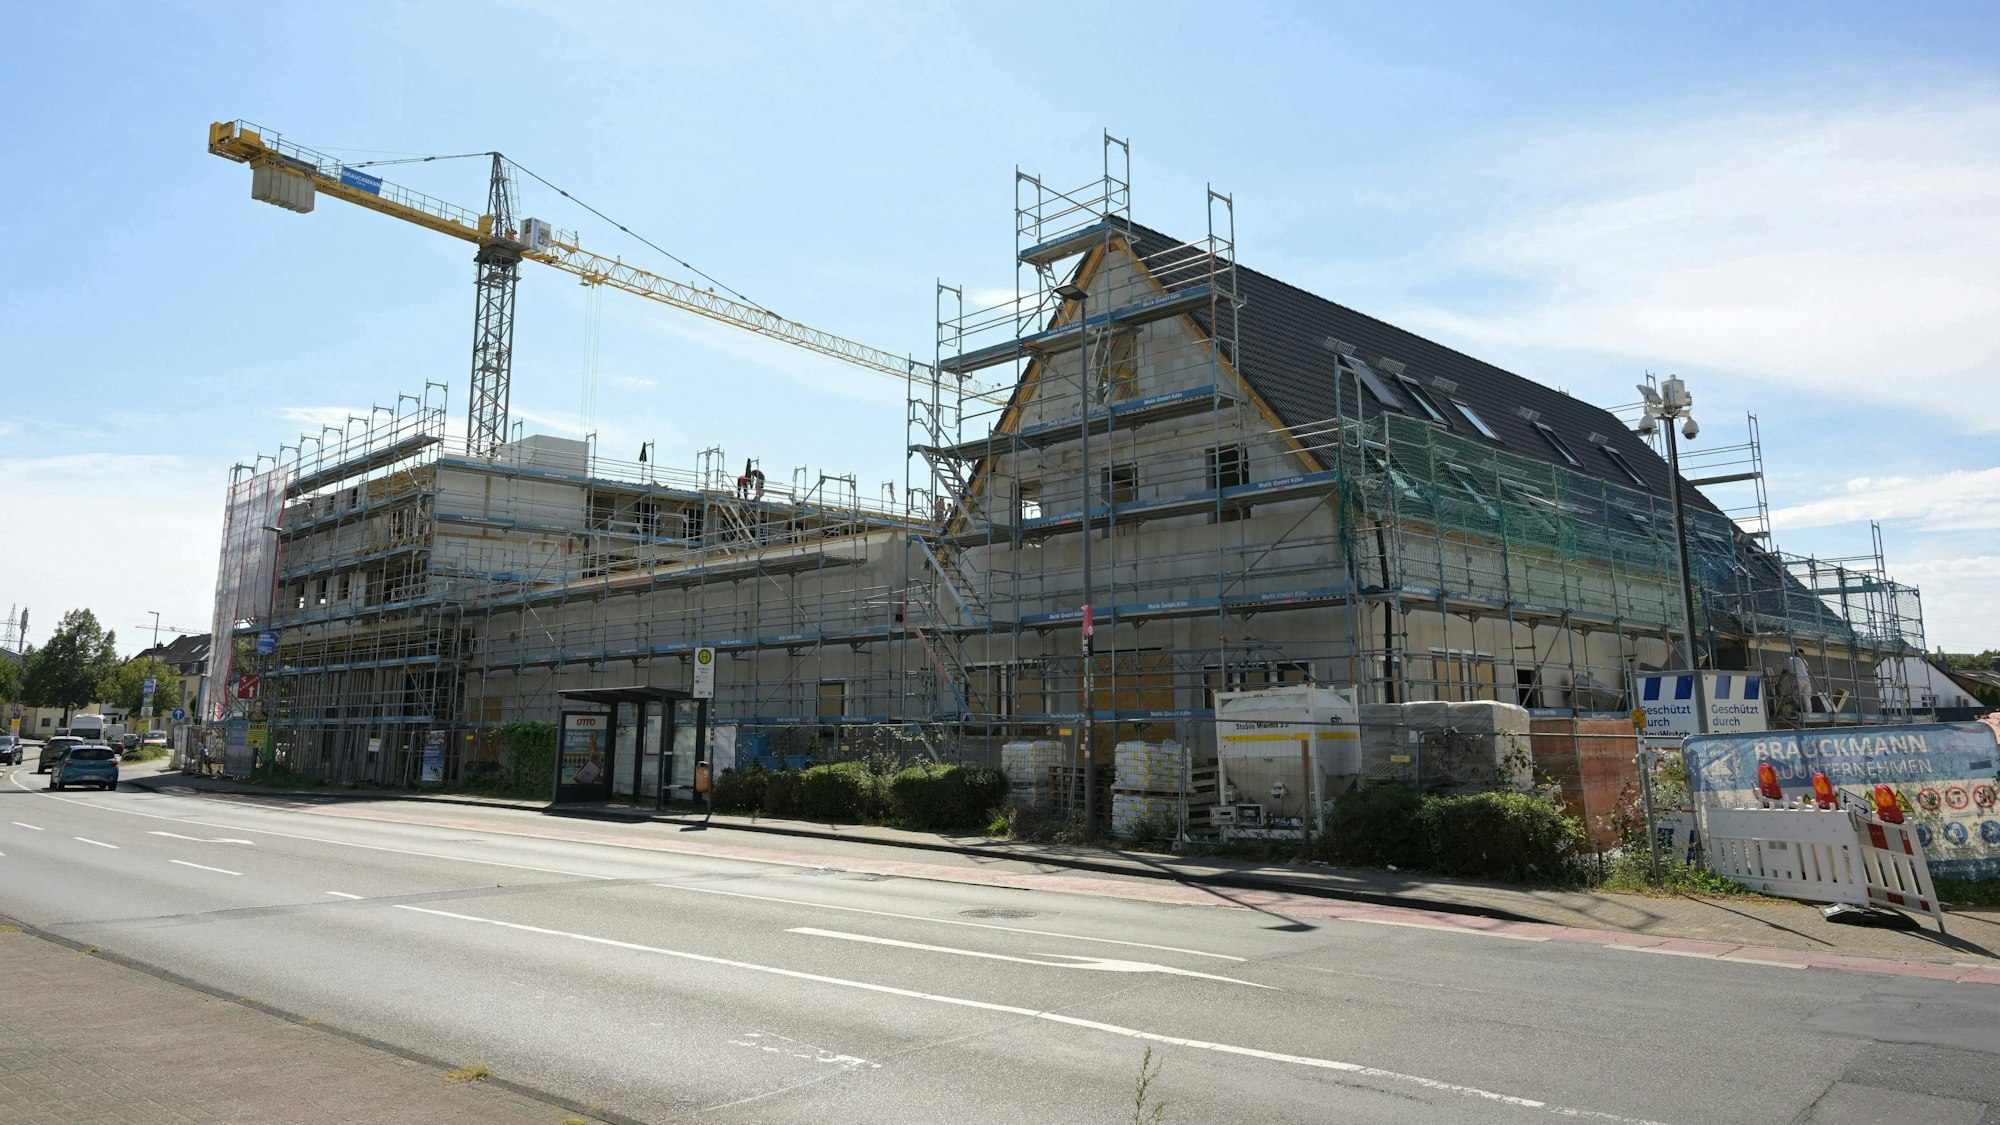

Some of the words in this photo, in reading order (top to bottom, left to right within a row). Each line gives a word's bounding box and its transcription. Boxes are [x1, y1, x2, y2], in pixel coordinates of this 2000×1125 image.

[343, 171, 380, 188] BRAUCKMANN
[1273, 478, 1290, 486] GmbH
[1711, 704, 1759, 715] Geschützt
[1647, 716, 1670, 727] urch
[1712, 716, 1740, 726] durch
[1754, 734, 1928, 760] BRAUCKMANN
[1772, 759, 1932, 781] AUUNTERNEHMEN
